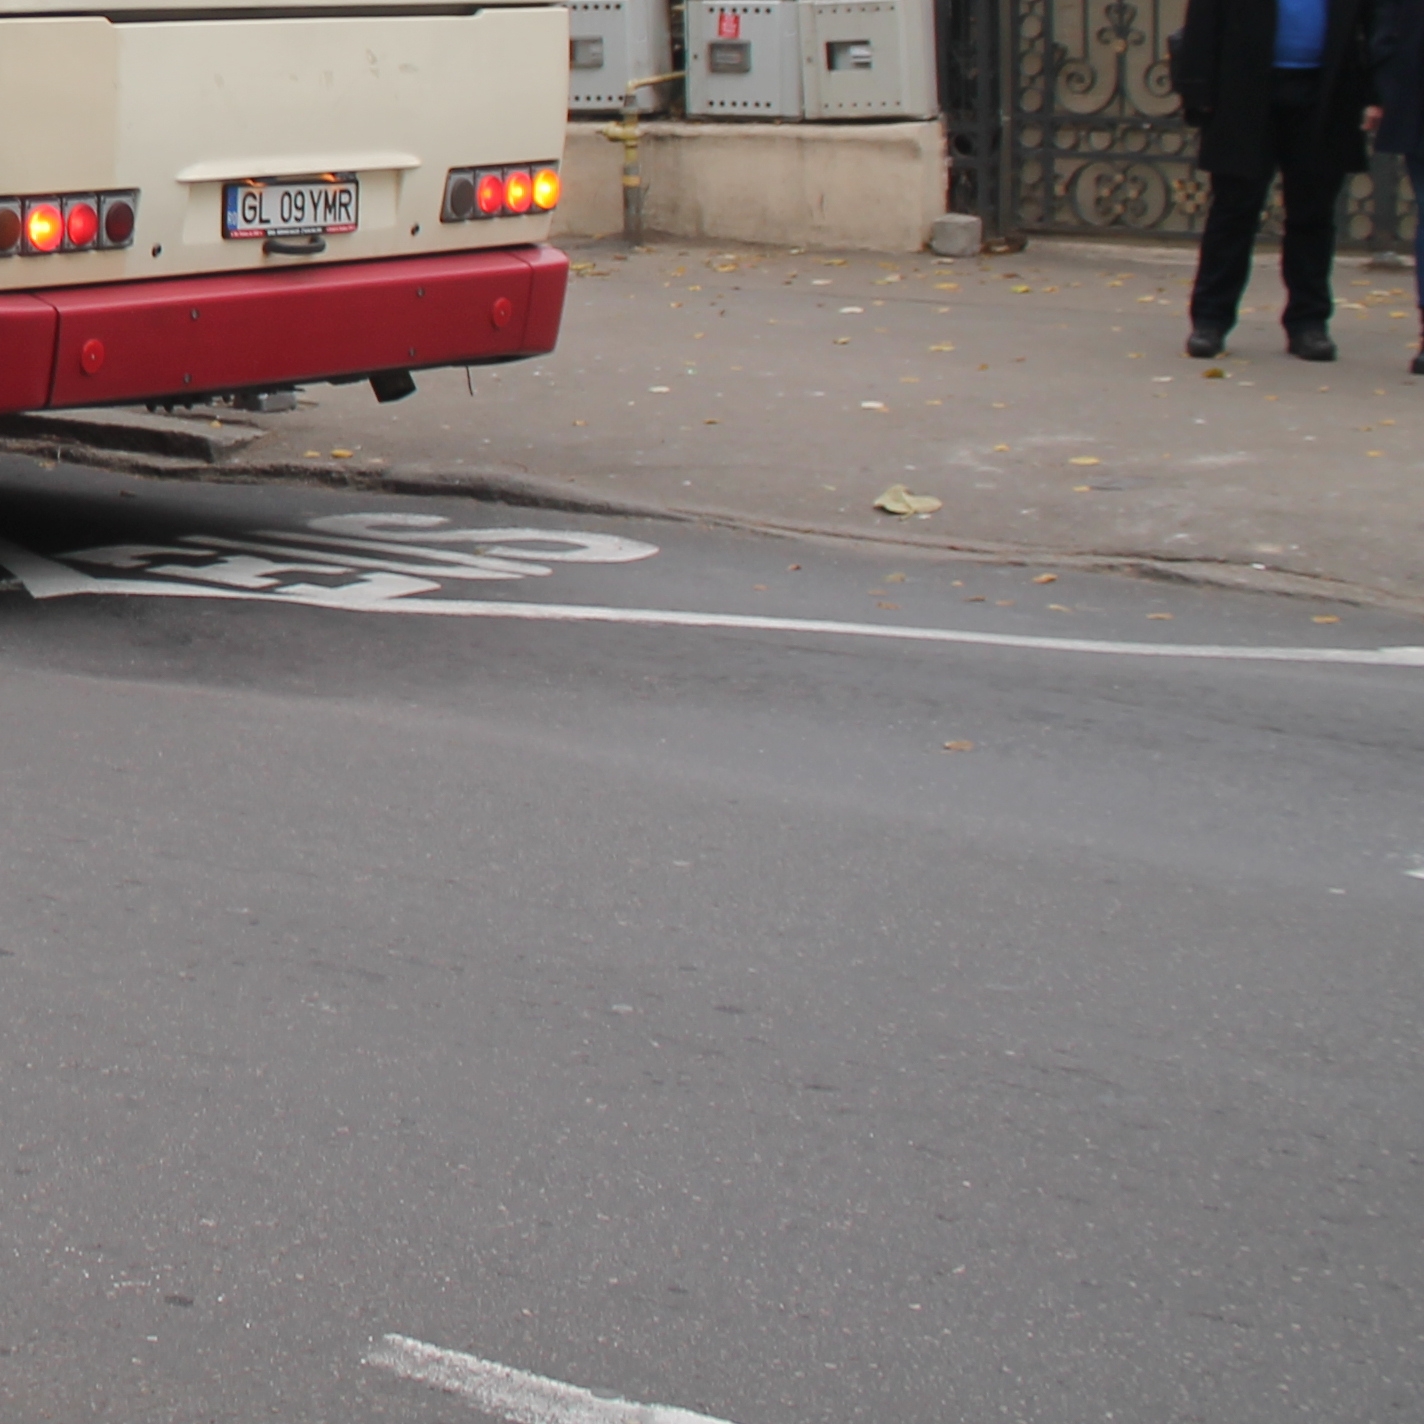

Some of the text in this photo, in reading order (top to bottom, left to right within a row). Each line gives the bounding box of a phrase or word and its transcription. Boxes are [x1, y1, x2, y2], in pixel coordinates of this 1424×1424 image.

[242, 191, 271, 225] GL
[280, 190, 306, 223] 09
[309, 188, 352, 222] YMR
[51, 512, 659, 598] BUS
